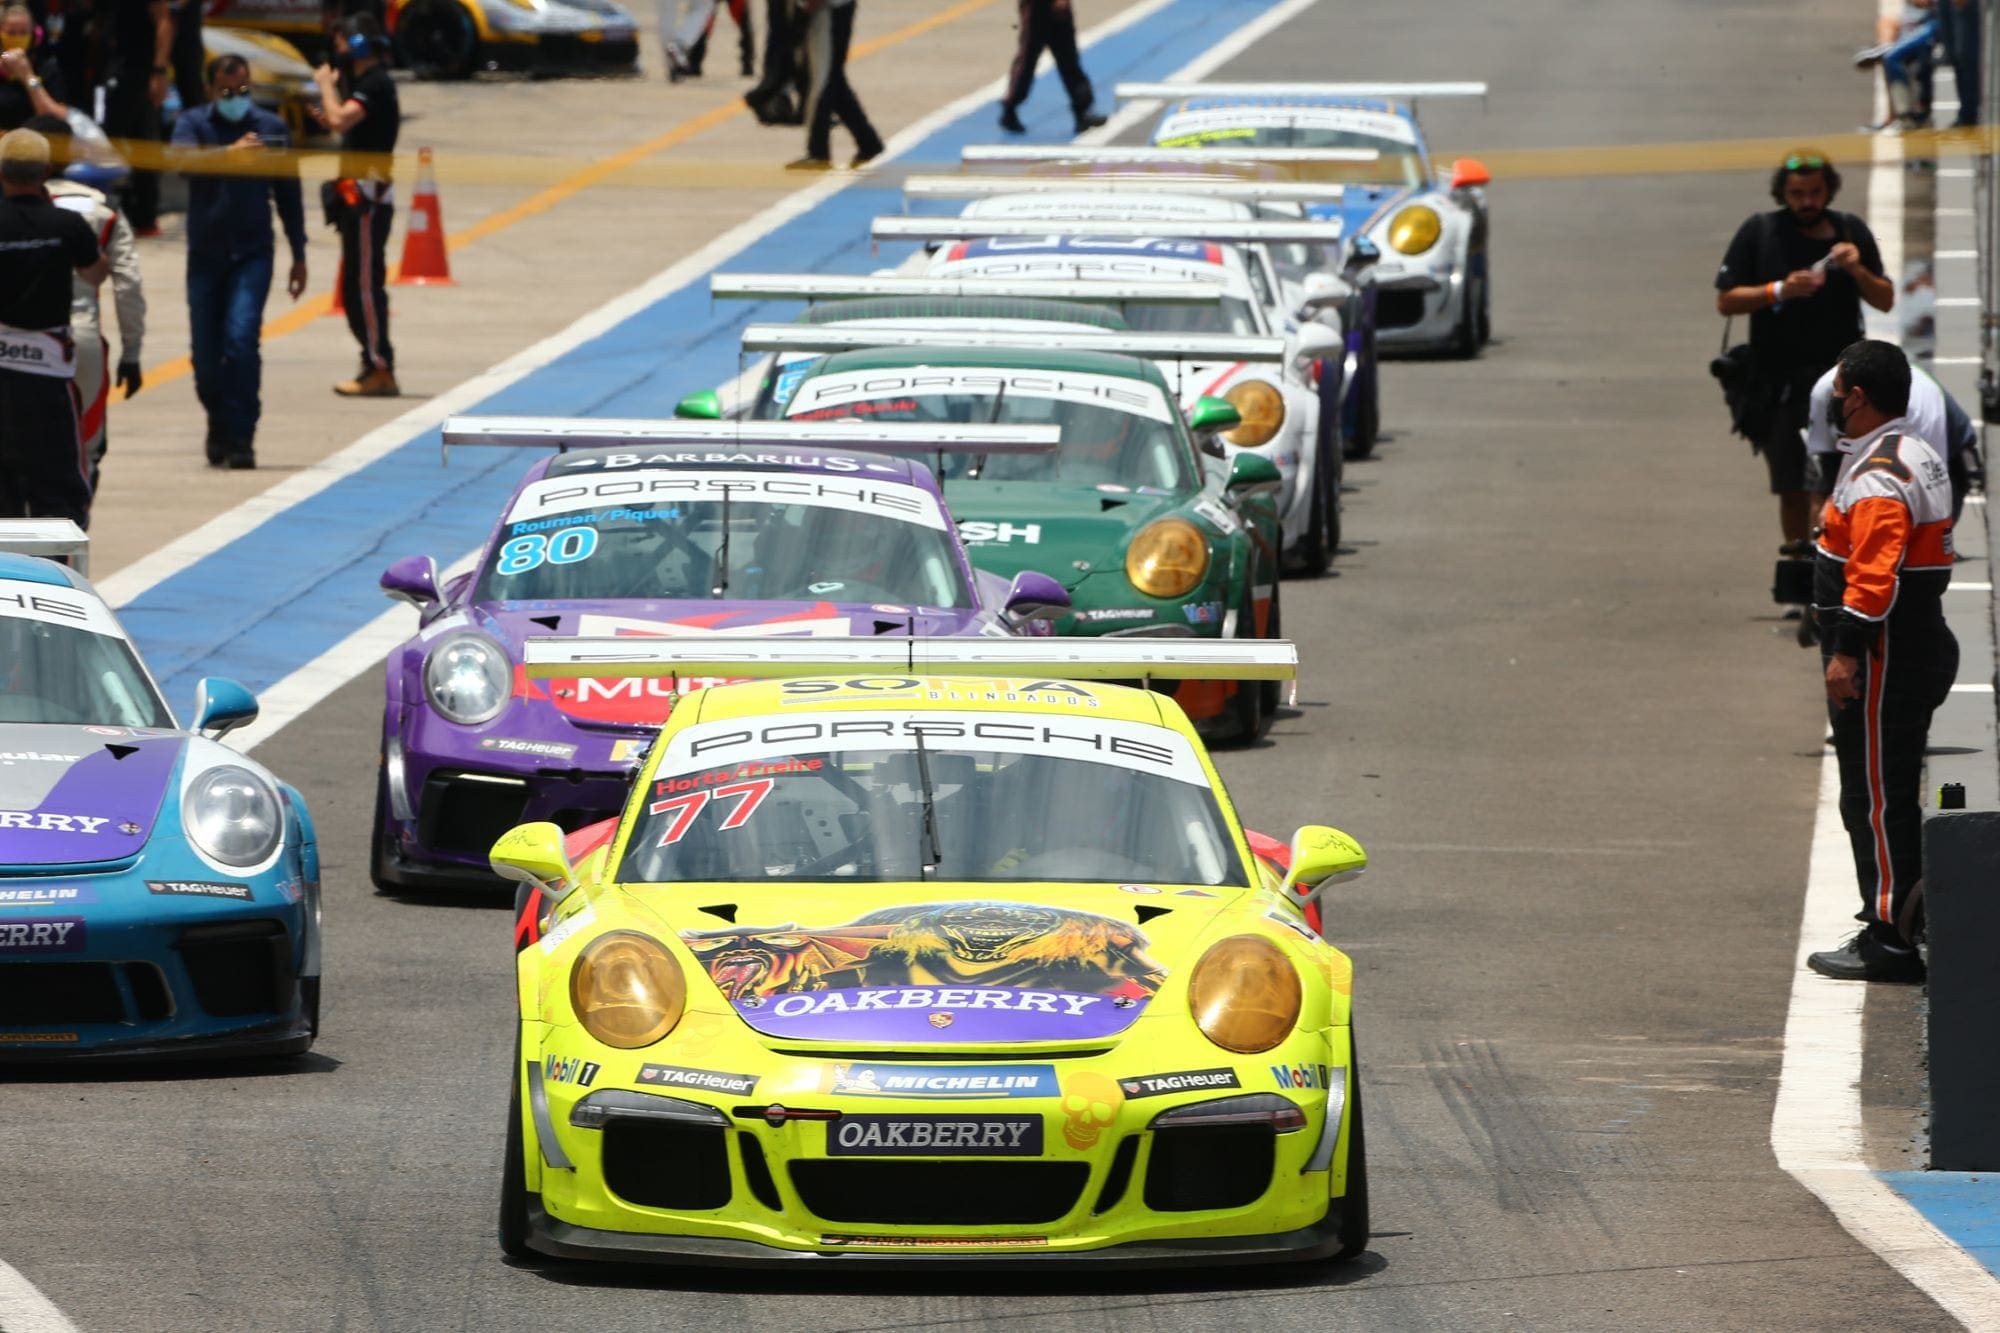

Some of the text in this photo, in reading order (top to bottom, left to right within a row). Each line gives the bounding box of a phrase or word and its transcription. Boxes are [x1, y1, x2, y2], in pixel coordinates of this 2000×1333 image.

[815, 376, 1150, 408] PORSCHE
[603, 452, 861, 472] BARBARIUS
[538, 479, 922, 515] PORSCHE
[511, 506, 680, 537] Rouman/Piquet
[496, 525, 599, 577] 80
[577, 677, 750, 703] Mut
[781, 678, 1094, 697] SOMA
[690, 719, 1174, 767] PORSCHE
[655, 757, 823, 797] Horta/Freire
[650, 778, 775, 849] 77
[773, 989, 1101, 1017] OAKBERRY
[544, 1054, 581, 1084] Mobil
[884, 1075, 1039, 1090] MICHELIN
[1270, 1063, 1318, 1090] Mobil
[838, 1122, 1031, 1148] OAKBERRY
